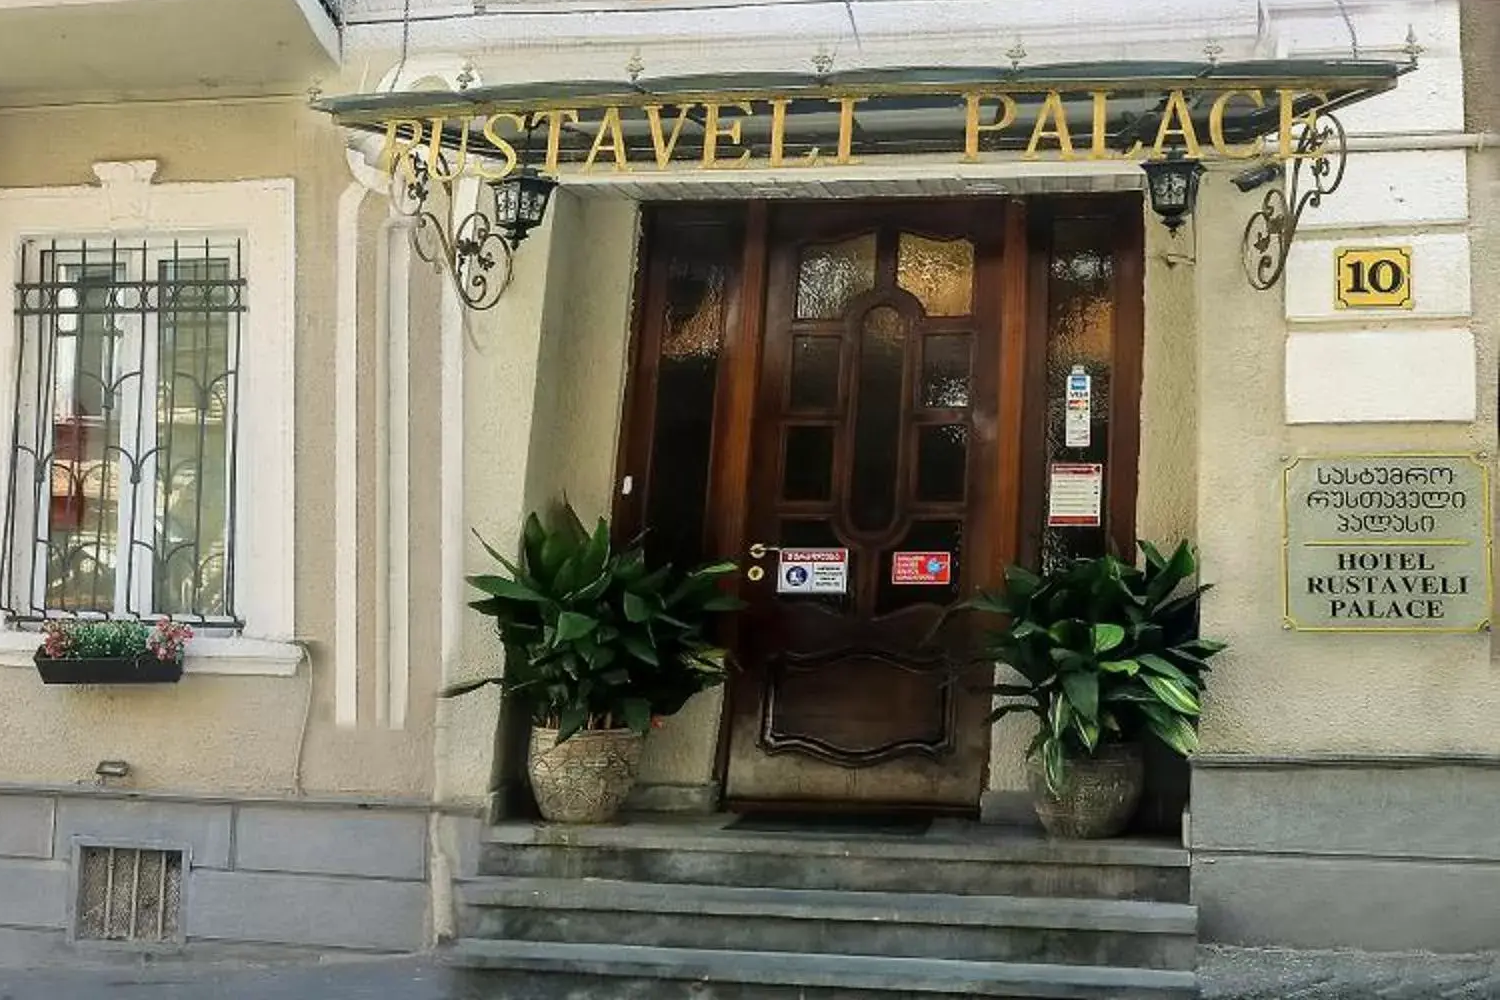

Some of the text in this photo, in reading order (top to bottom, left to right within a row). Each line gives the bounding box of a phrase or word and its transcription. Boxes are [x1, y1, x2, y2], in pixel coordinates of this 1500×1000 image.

[378, 88, 1329, 183] RUSTAVELI PALACE
[1346, 259, 1405, 294] 10
[1317, 467, 1454, 485] სასტუმრო
[1307, 491, 1466, 509] რუსთაველი
[1337, 513, 1435, 532] პალასი
[1338, 553, 1434, 571] HOTEL
[1307, 576, 1469, 595] RUSTAVELI
[1329, 600, 1444, 619] PALACE
